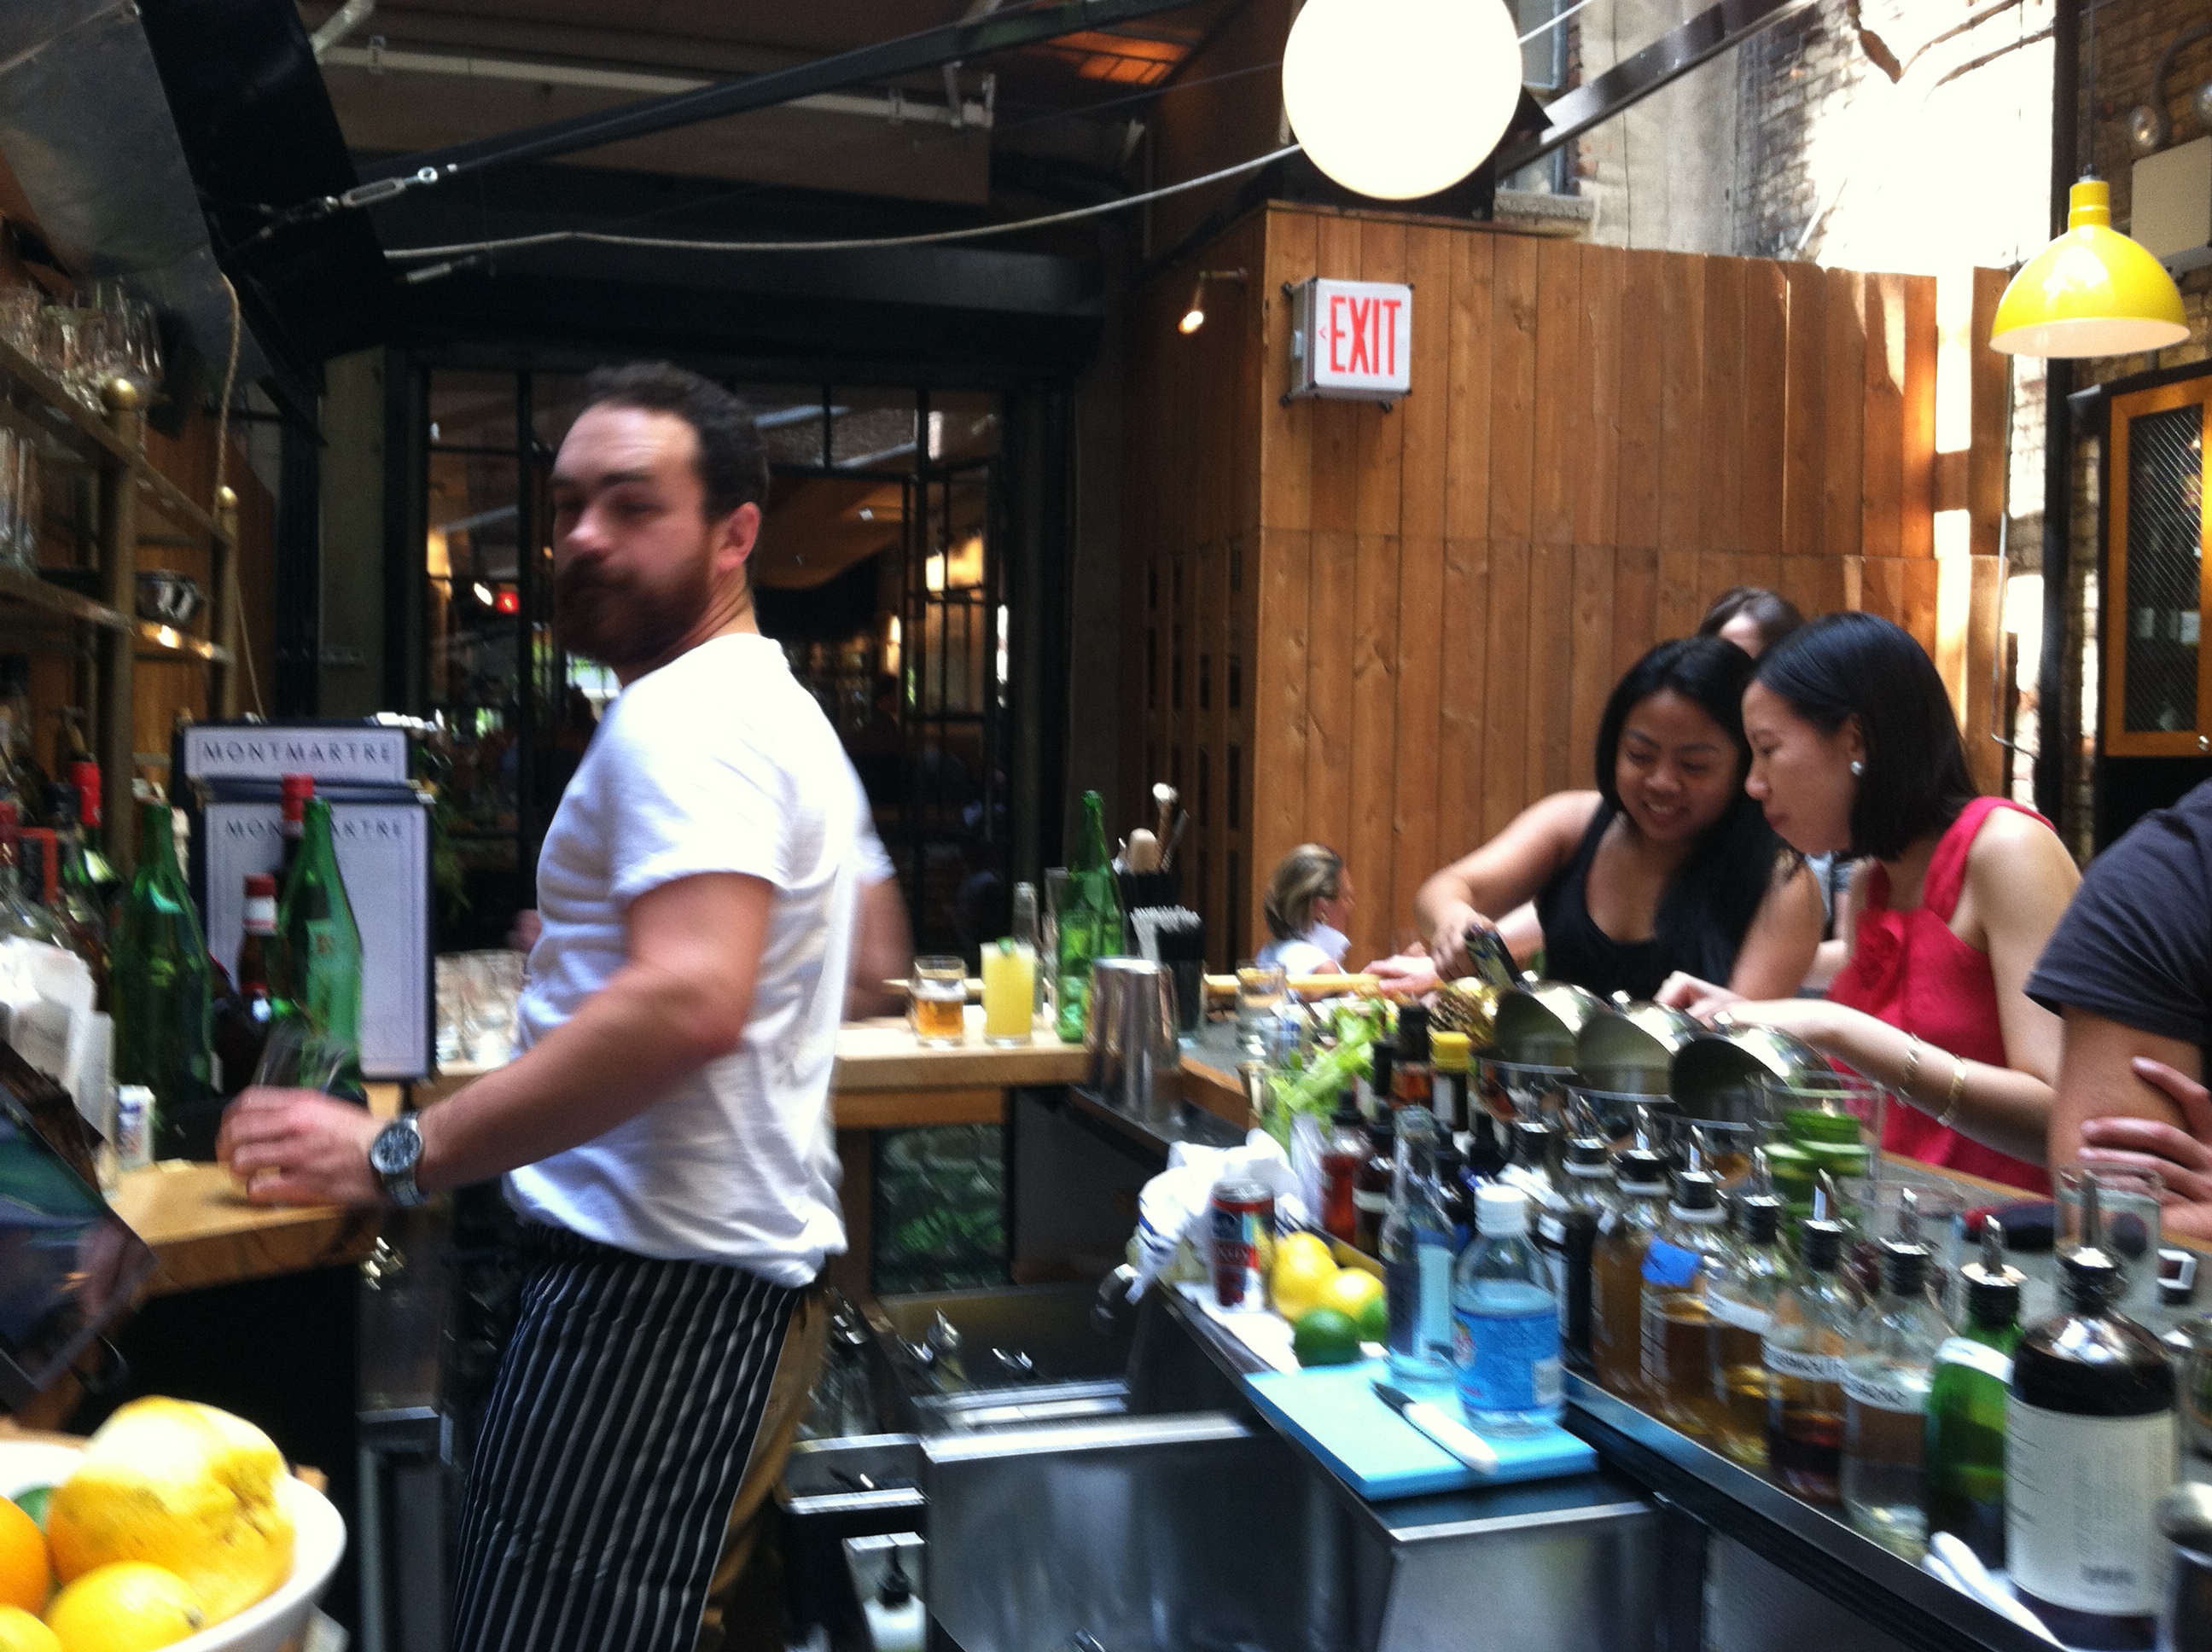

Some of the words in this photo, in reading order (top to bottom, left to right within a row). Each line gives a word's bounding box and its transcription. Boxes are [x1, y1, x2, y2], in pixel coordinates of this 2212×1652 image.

[1330, 296, 1400, 375] EXIT
[203, 741, 392, 765] MONTMARTRE
[225, 817, 401, 840] MONARTRE
